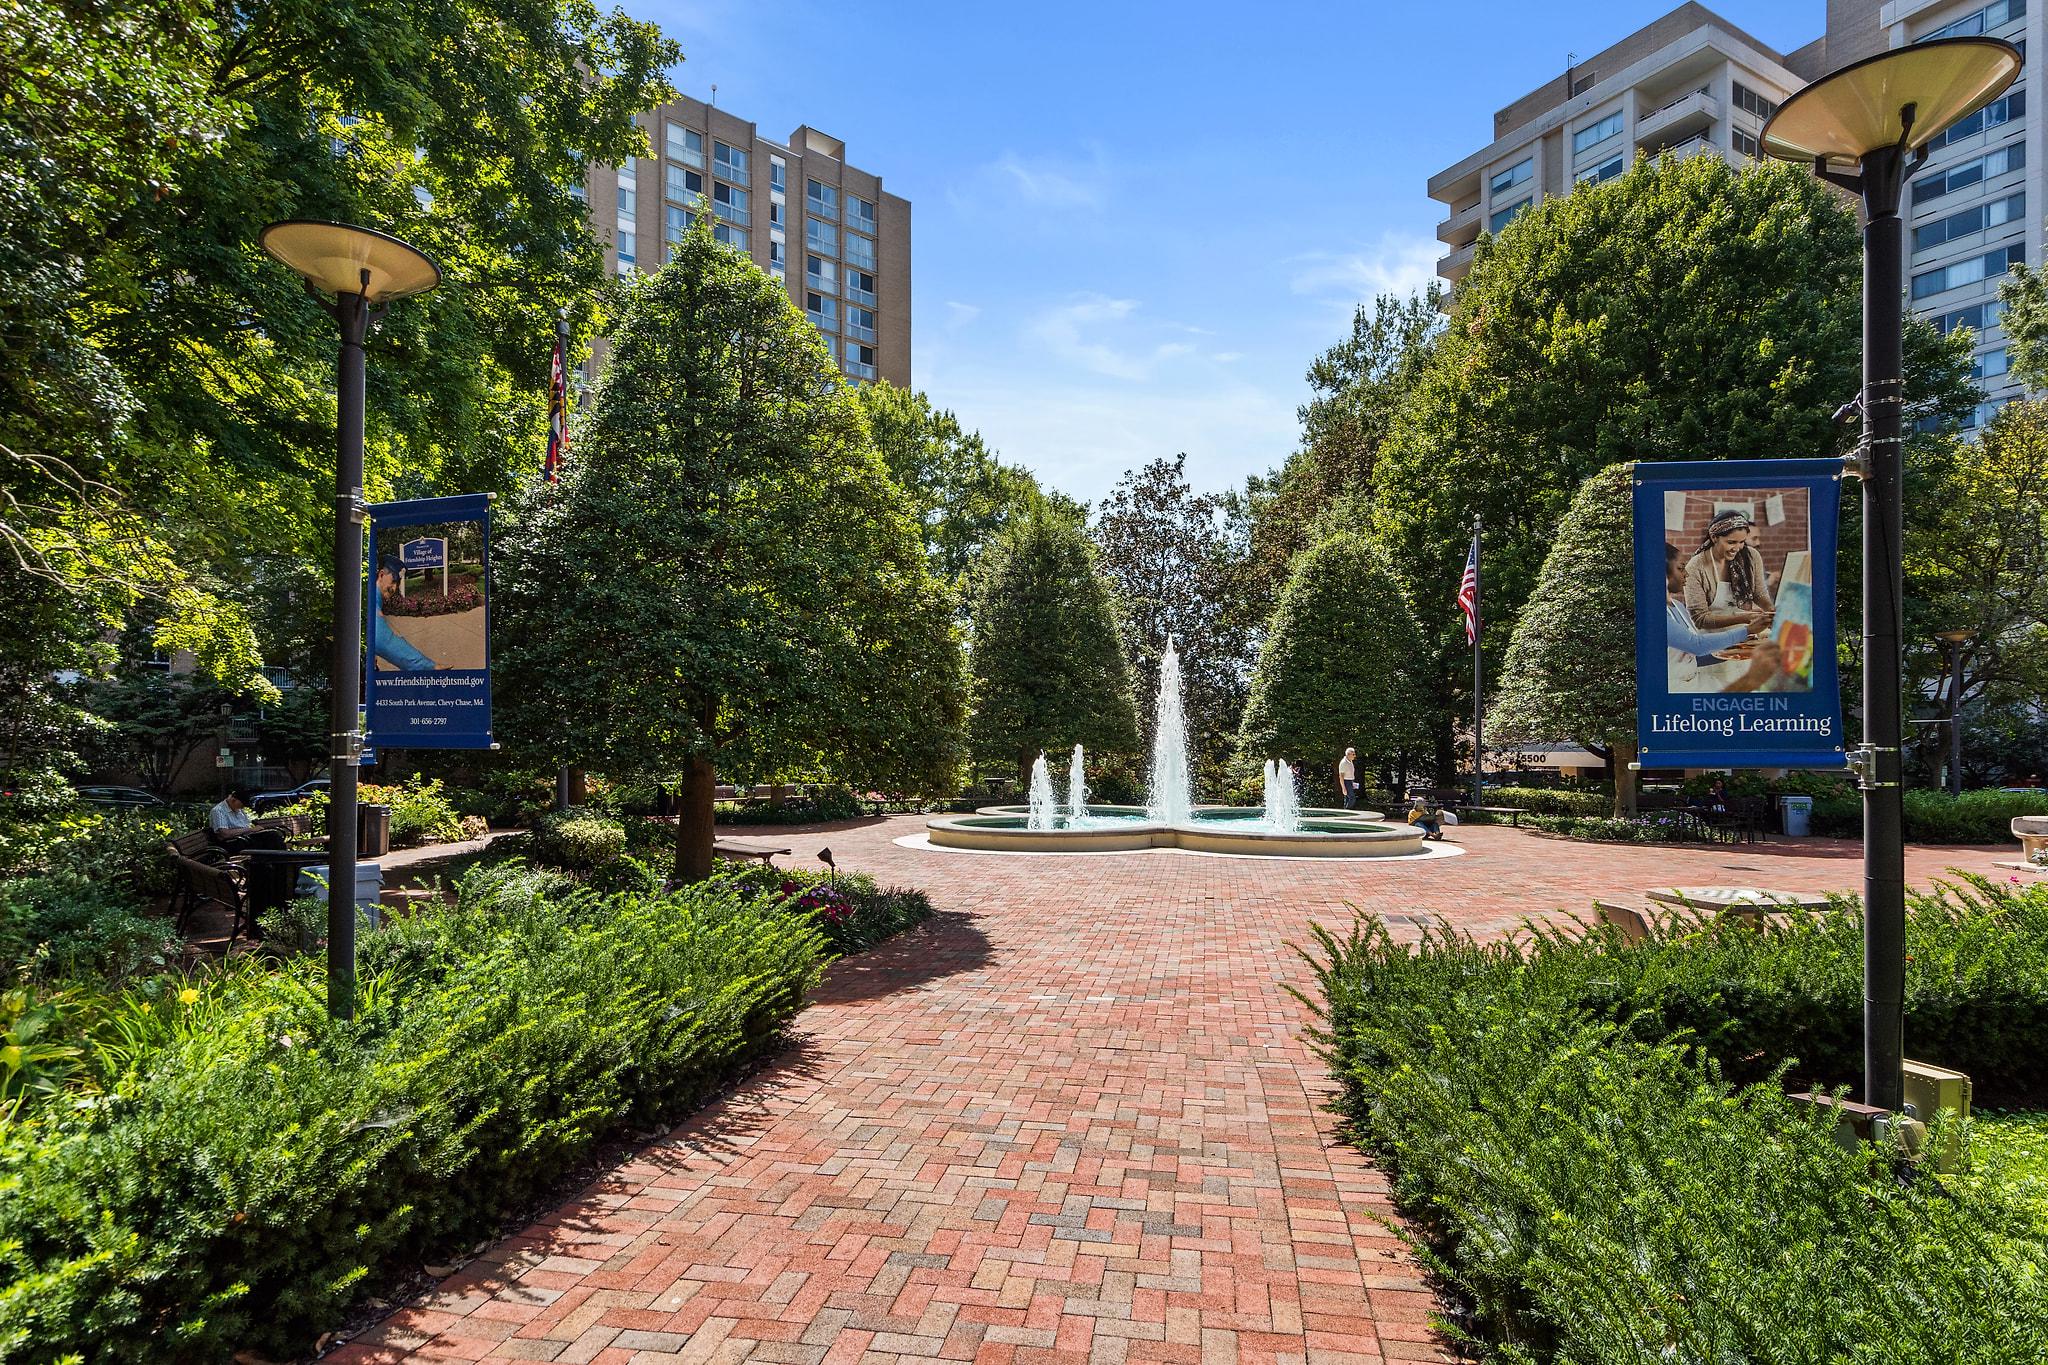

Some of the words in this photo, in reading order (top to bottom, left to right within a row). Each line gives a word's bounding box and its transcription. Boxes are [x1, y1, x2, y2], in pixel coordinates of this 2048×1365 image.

[405, 555, 425, 563] Friendship
[426, 554, 442, 563] Heights
[375, 676, 484, 688] www.friendshipheightsmd.gov
[437, 699, 454, 707] Chevy
[1692, 698, 1764, 711] ENGAGE
[1770, 697, 1788, 710] IN
[1652, 714, 1734, 737] Lifelong
[1739, 713, 1831, 736] Learning
[1521, 754, 1546, 763] 5500
